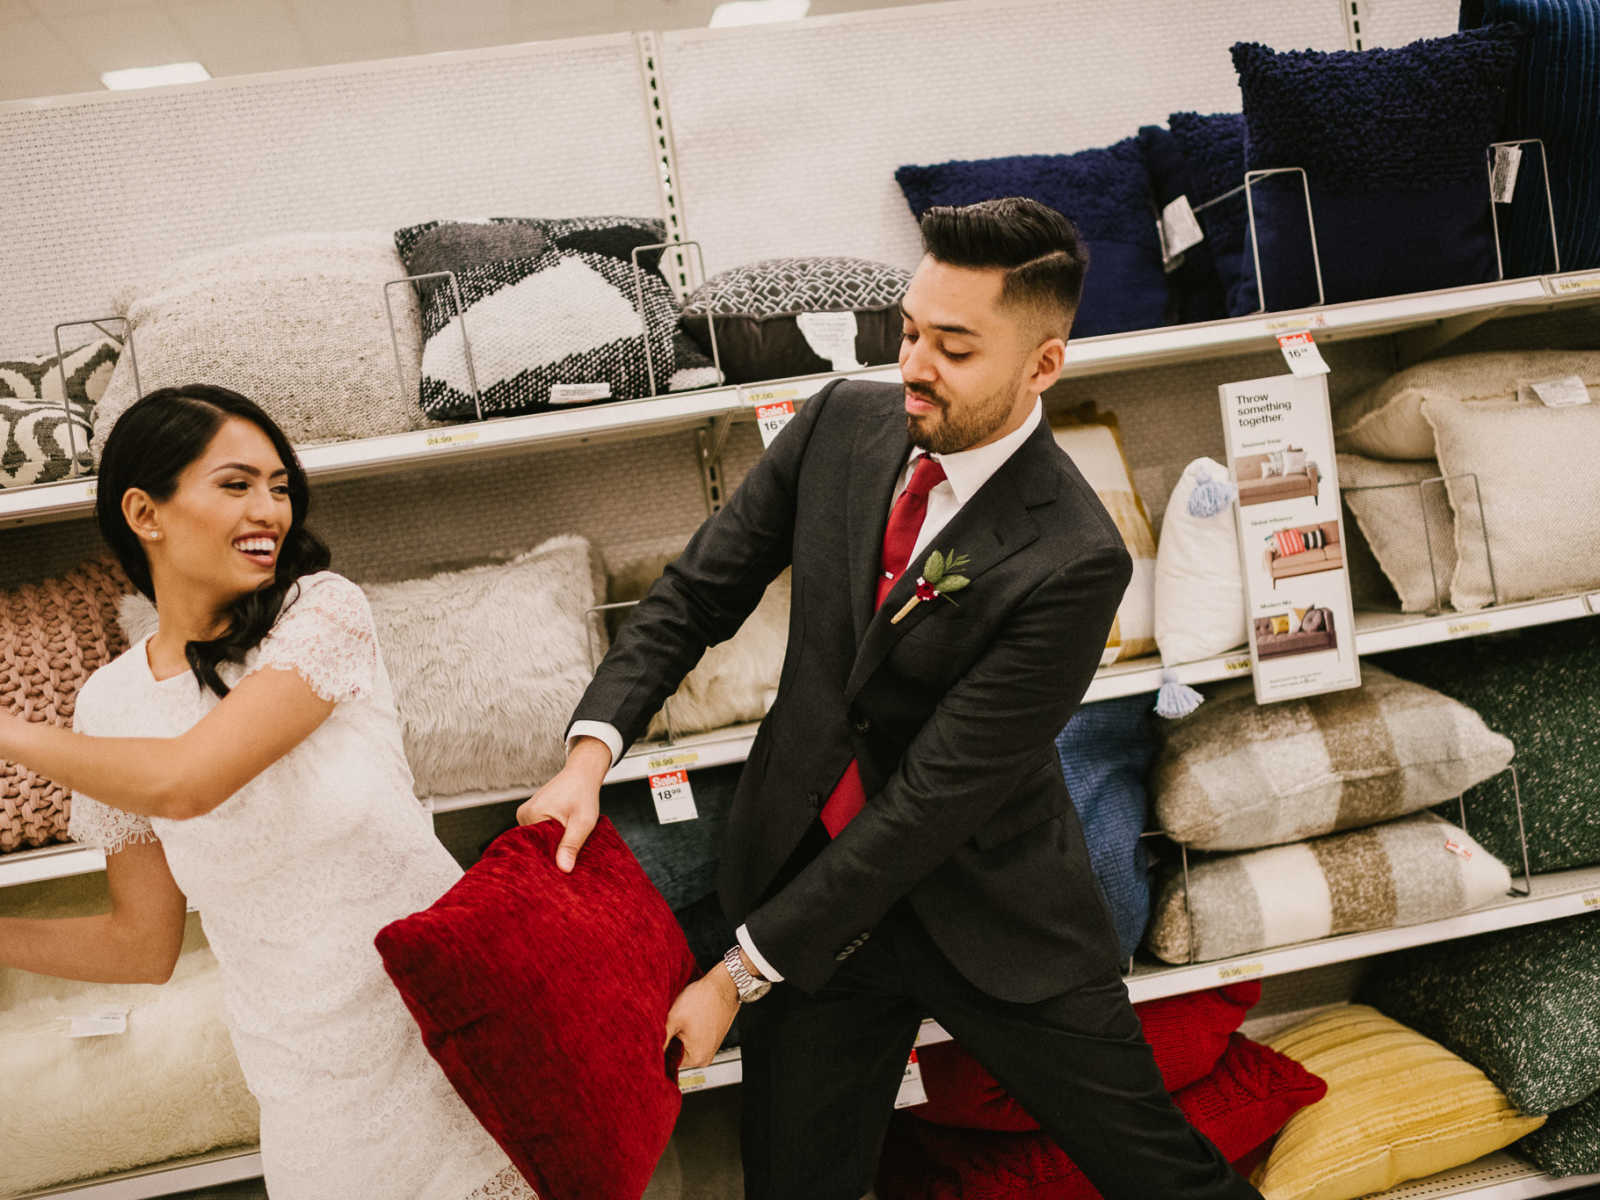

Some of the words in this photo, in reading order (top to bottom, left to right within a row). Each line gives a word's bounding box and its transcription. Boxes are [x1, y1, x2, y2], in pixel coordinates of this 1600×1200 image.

[1280, 333, 1310, 346] Sale!
[1236, 392, 1269, 405] Throw
[758, 403, 788, 418] Sale!
[1237, 400, 1292, 416] something
[652, 771, 683, 787] Sale!
